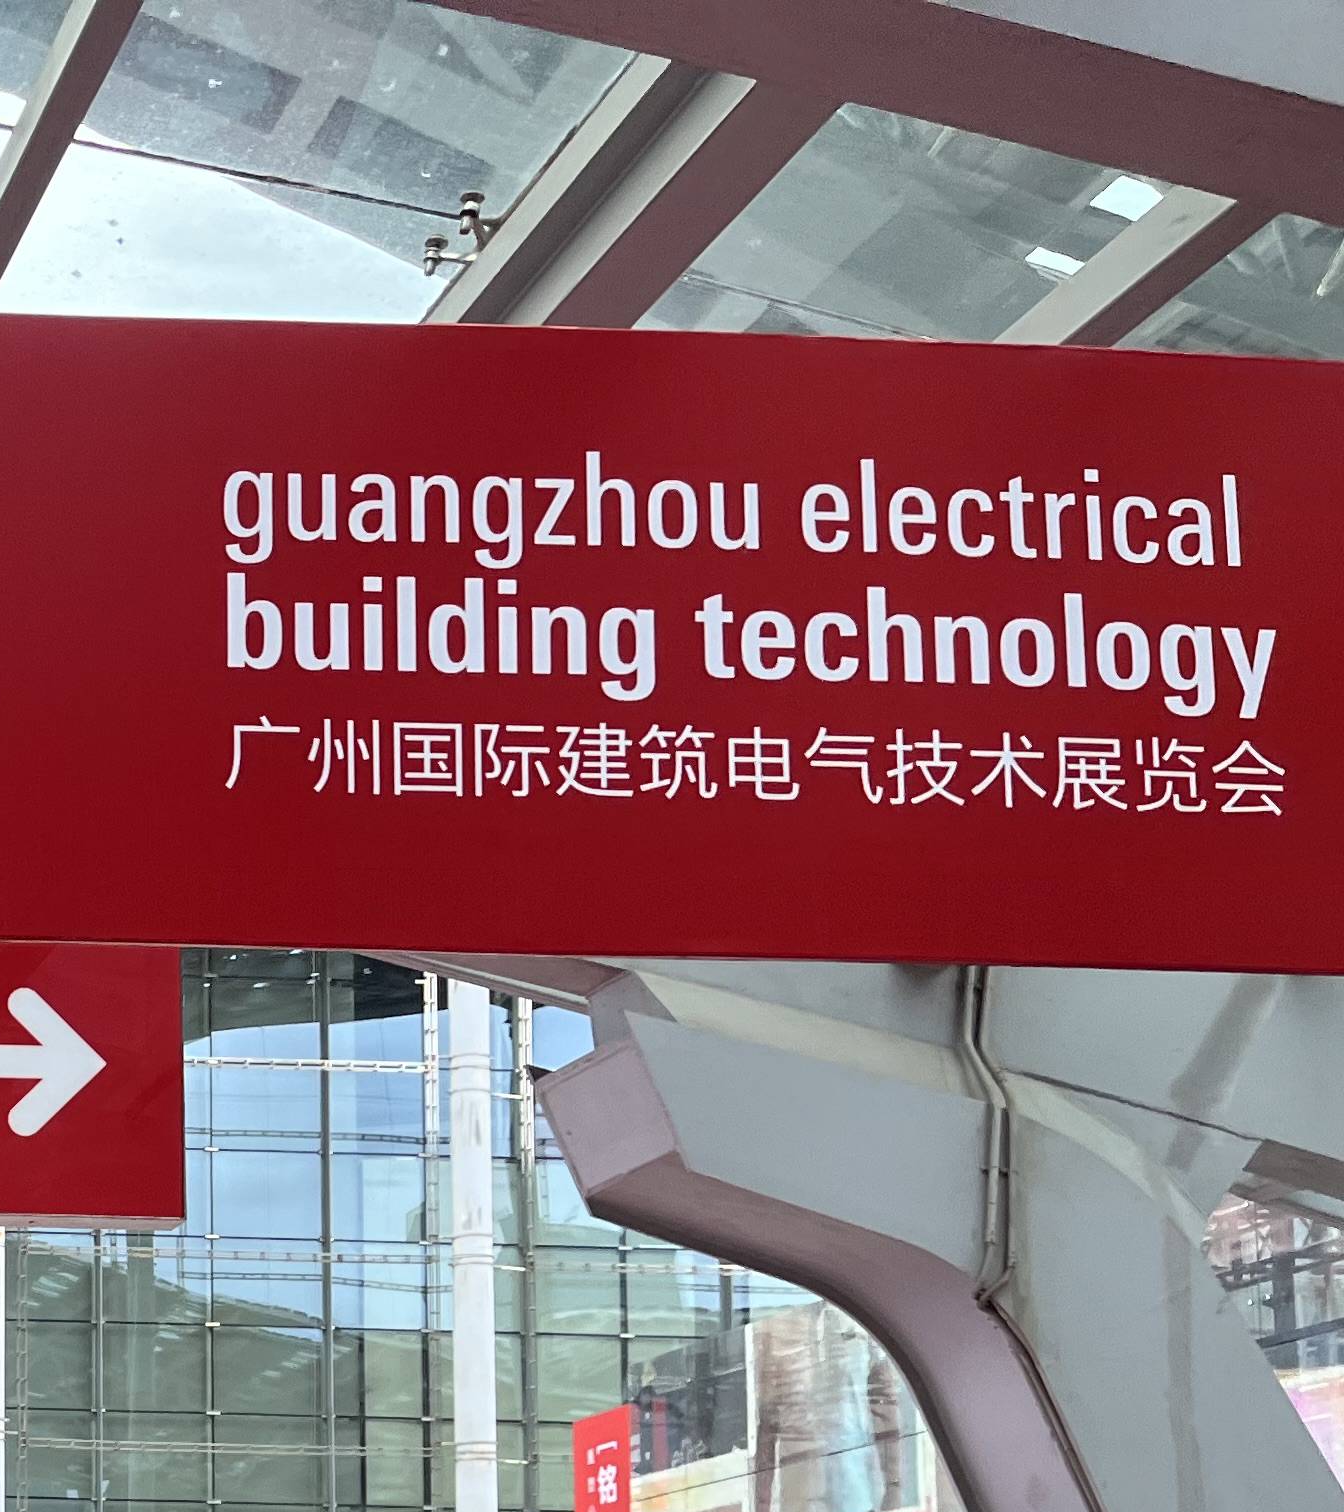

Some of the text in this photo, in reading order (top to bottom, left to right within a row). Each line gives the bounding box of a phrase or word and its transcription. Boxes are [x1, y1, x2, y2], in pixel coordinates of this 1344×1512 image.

[222, 452, 1242, 569] guangzhou electrical
[225, 574, 1277, 720] building technology
[224, 715, 1287, 817] 广州国际建筑电气技术展览会
